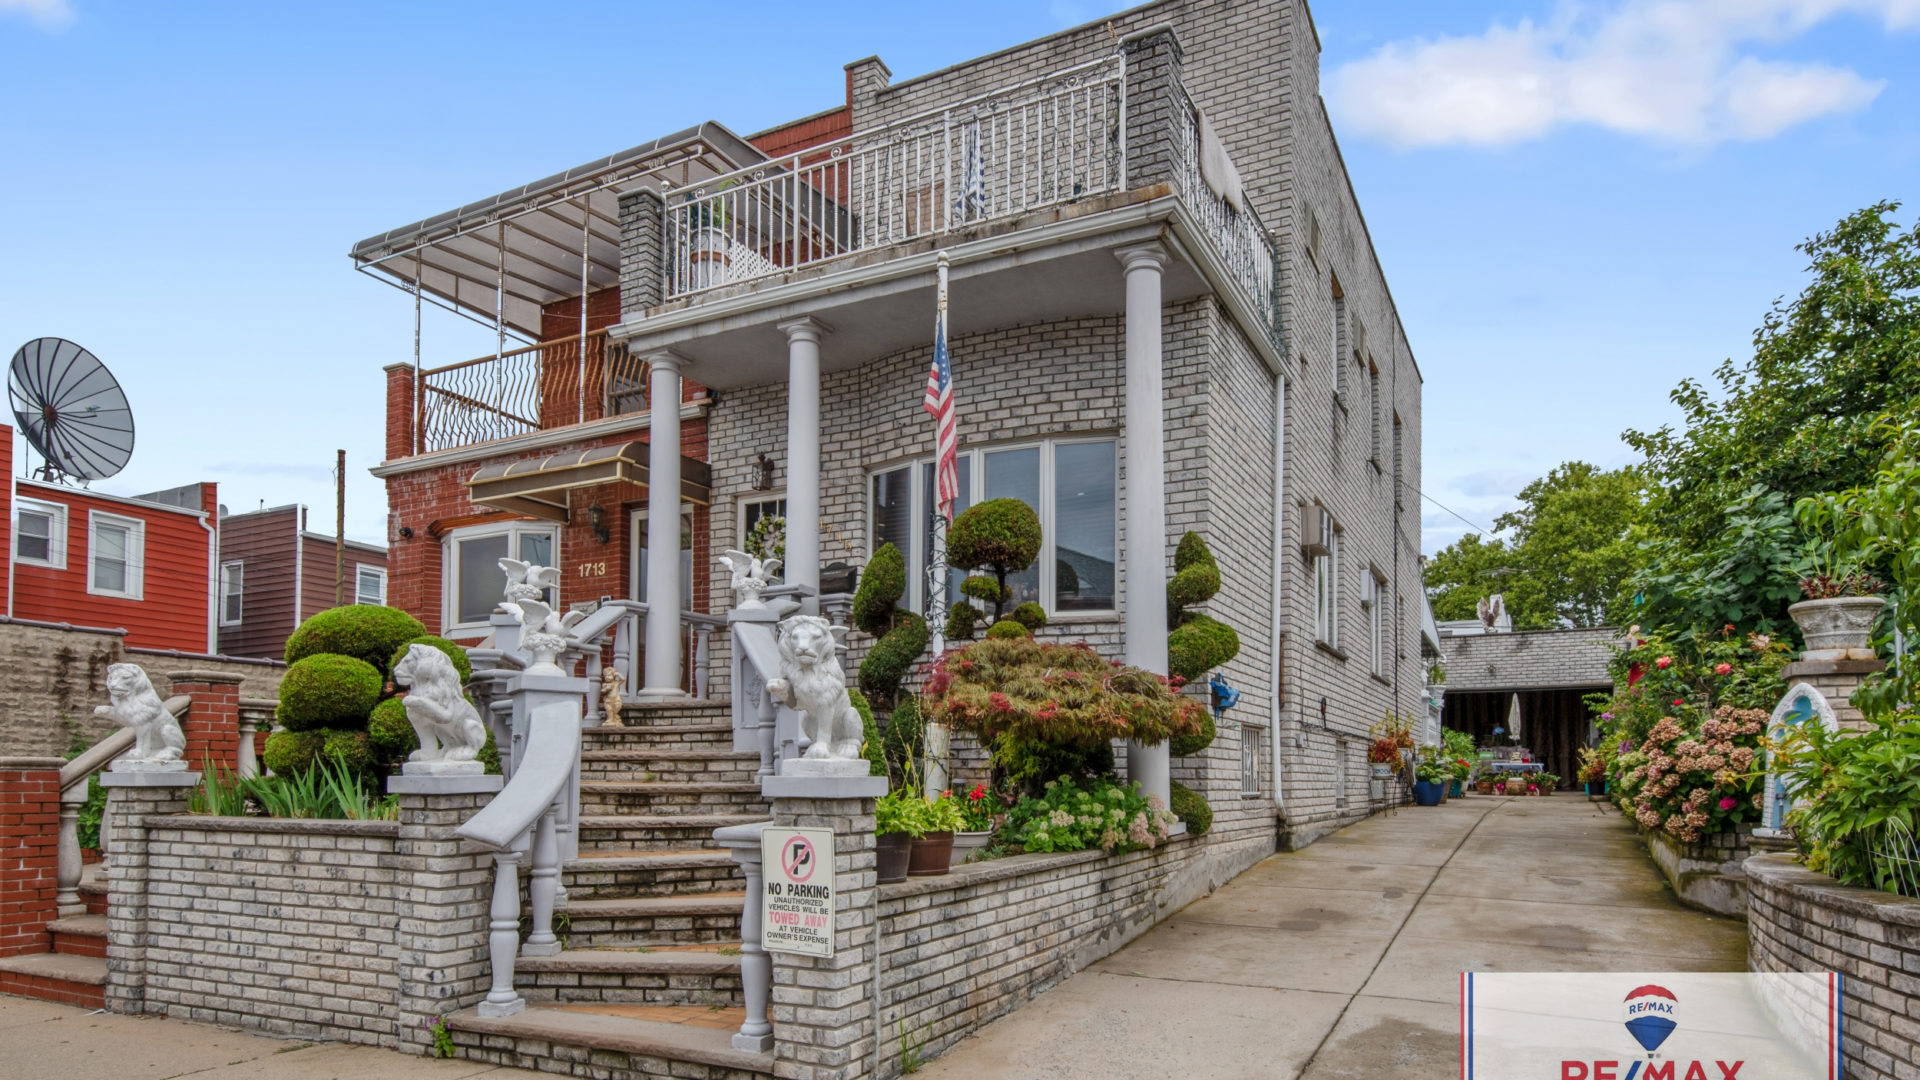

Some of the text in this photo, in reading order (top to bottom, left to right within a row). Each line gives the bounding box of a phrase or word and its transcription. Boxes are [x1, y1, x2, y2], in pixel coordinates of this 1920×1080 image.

[579, 562, 605, 577] 1713
[768, 882, 829, 899] NO PARKING
[774, 897, 823, 907] UNAUTHORIZED
[768, 904, 800, 912] VEHICLES
[802, 906, 817, 914] WILL
[769, 911, 827, 928] TOWED AWAY
[790, 927, 818, 935] VEHICLE
[767, 932, 829, 944] OWNER'S EXPENSE
